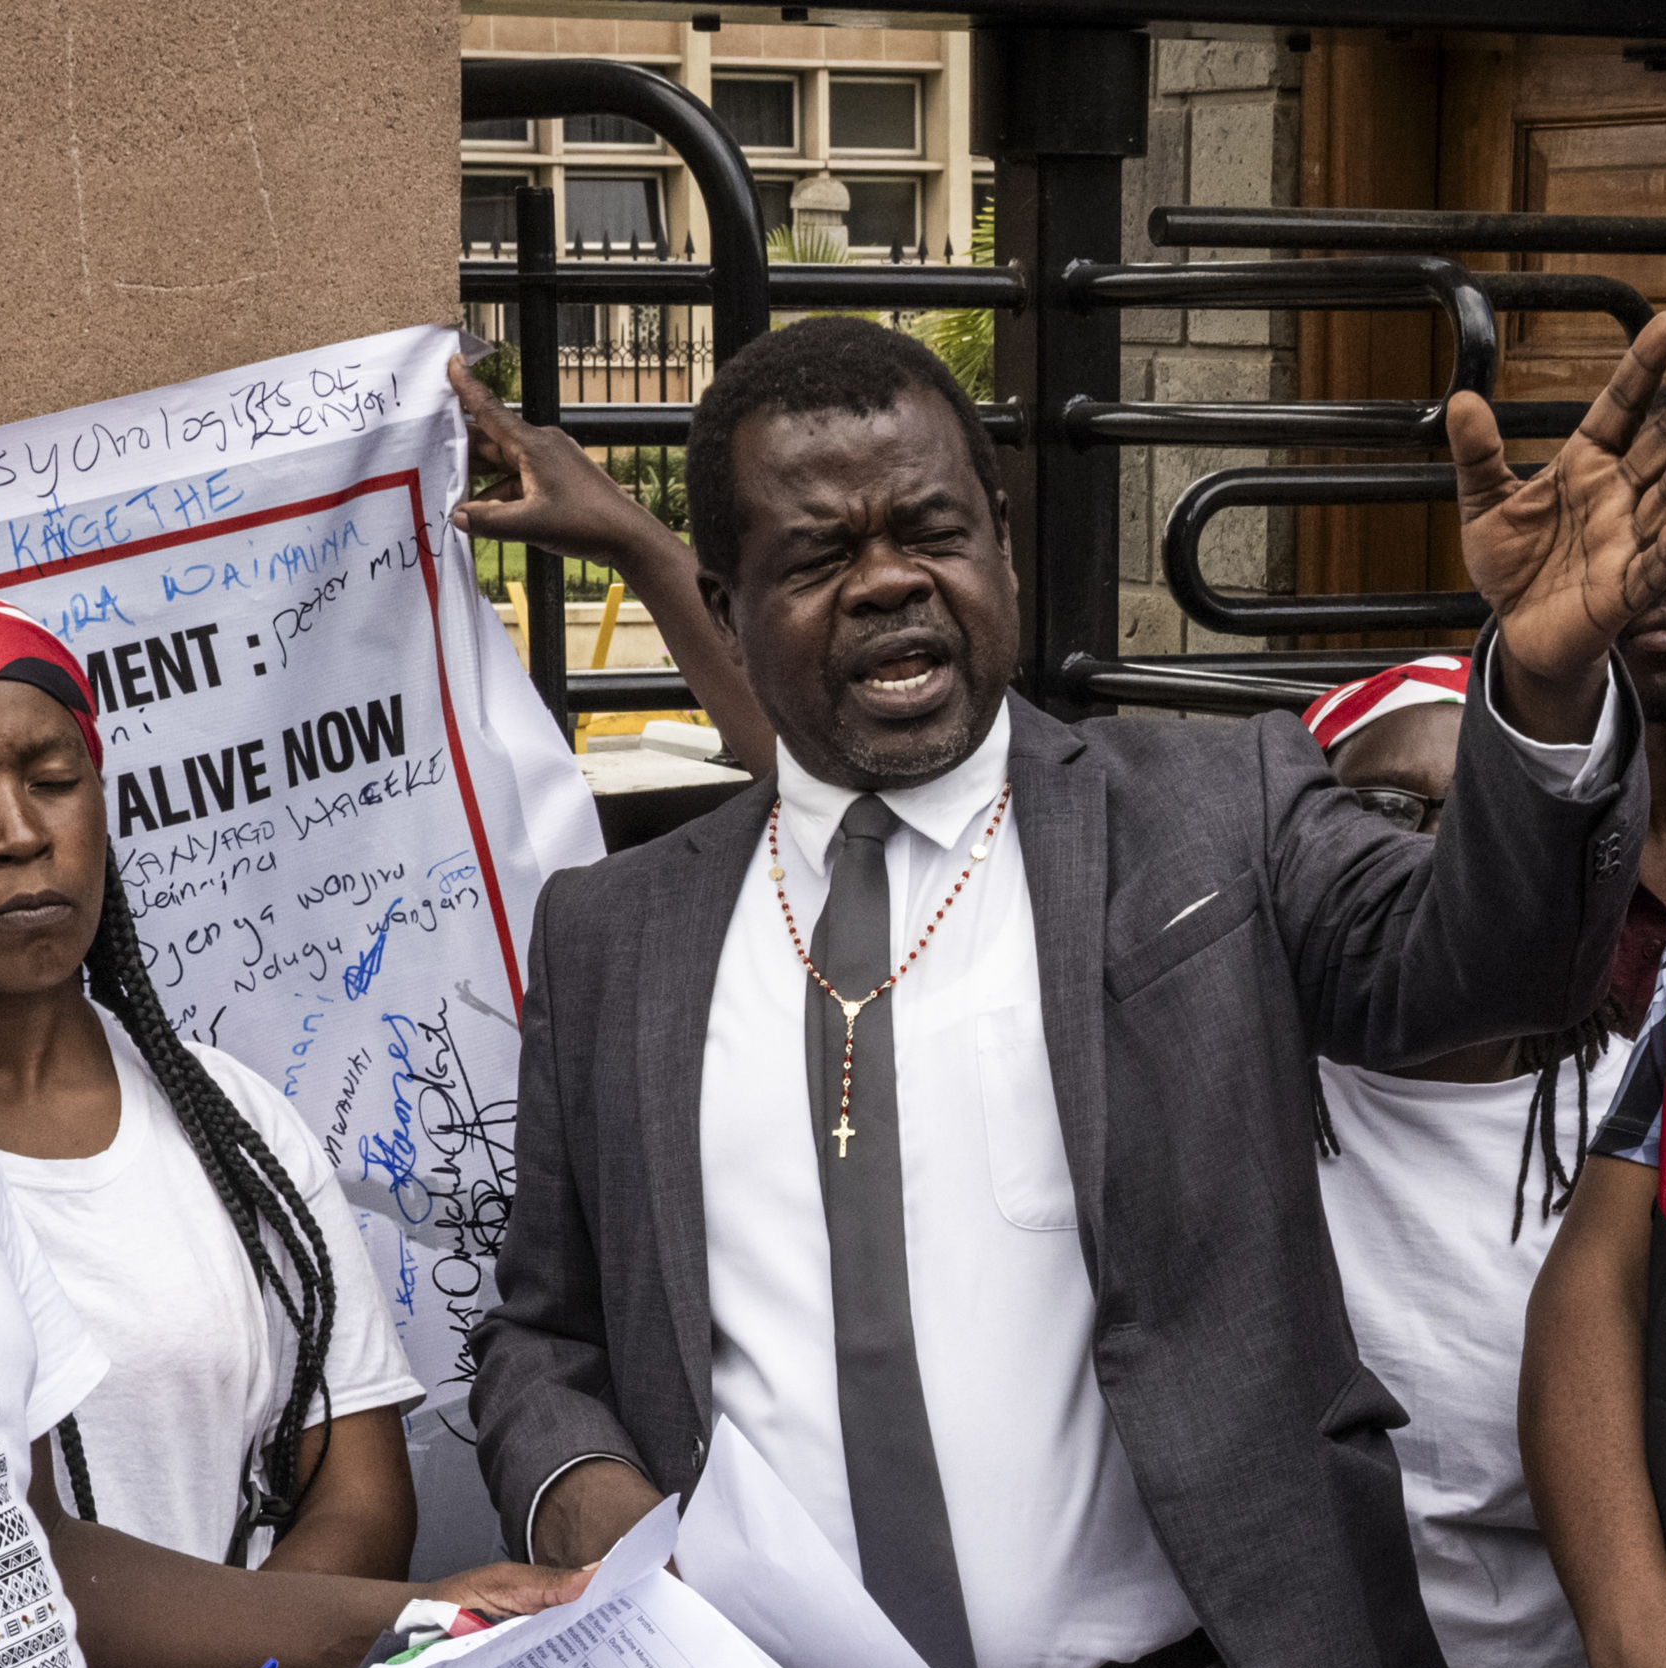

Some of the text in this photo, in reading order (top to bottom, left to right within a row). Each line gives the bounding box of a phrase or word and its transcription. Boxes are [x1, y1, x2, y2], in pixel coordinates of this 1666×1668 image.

[118, 693, 406, 839] ALIVE NOW
[636, 1614, 656, 1636] brother
[554, 1631, 578, 1657] awrence
[607, 1636, 626, 1656] Dume
[617, 1628, 638, 1651] Pauline
